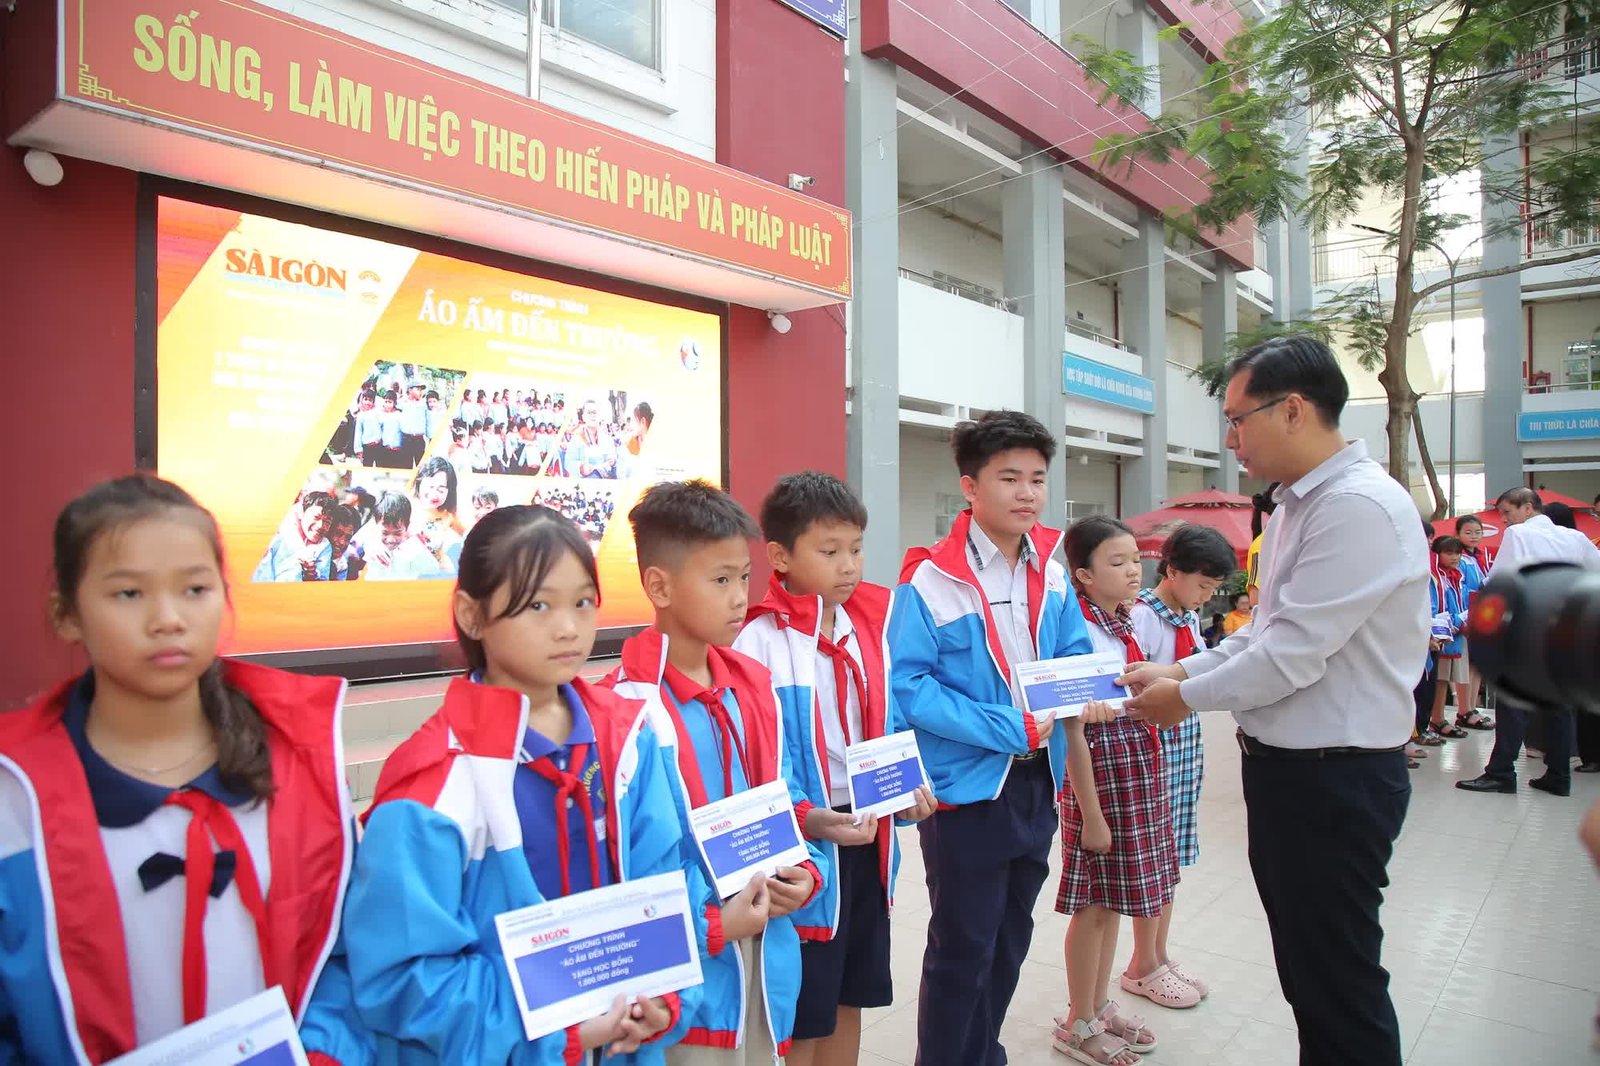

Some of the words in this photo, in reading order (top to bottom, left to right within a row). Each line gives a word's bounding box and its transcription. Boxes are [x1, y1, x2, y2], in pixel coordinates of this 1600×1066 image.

[133, 10, 274, 112] SỐNG,
[289, 58, 372, 133] LÀM
[384, 94, 461, 161] VIỆC
[471, 119, 546, 183] THEO
[556, 145, 618, 204] HIẾN
[627, 173, 690, 223] PHÁP
[697, 187, 726, 236] VÀ
[731, 205, 784, 251] PHÁP
[789, 222, 832, 270] LUẬT
[225, 248, 347, 291] SÀIGÒN
[417, 288, 457, 326] ÁO
